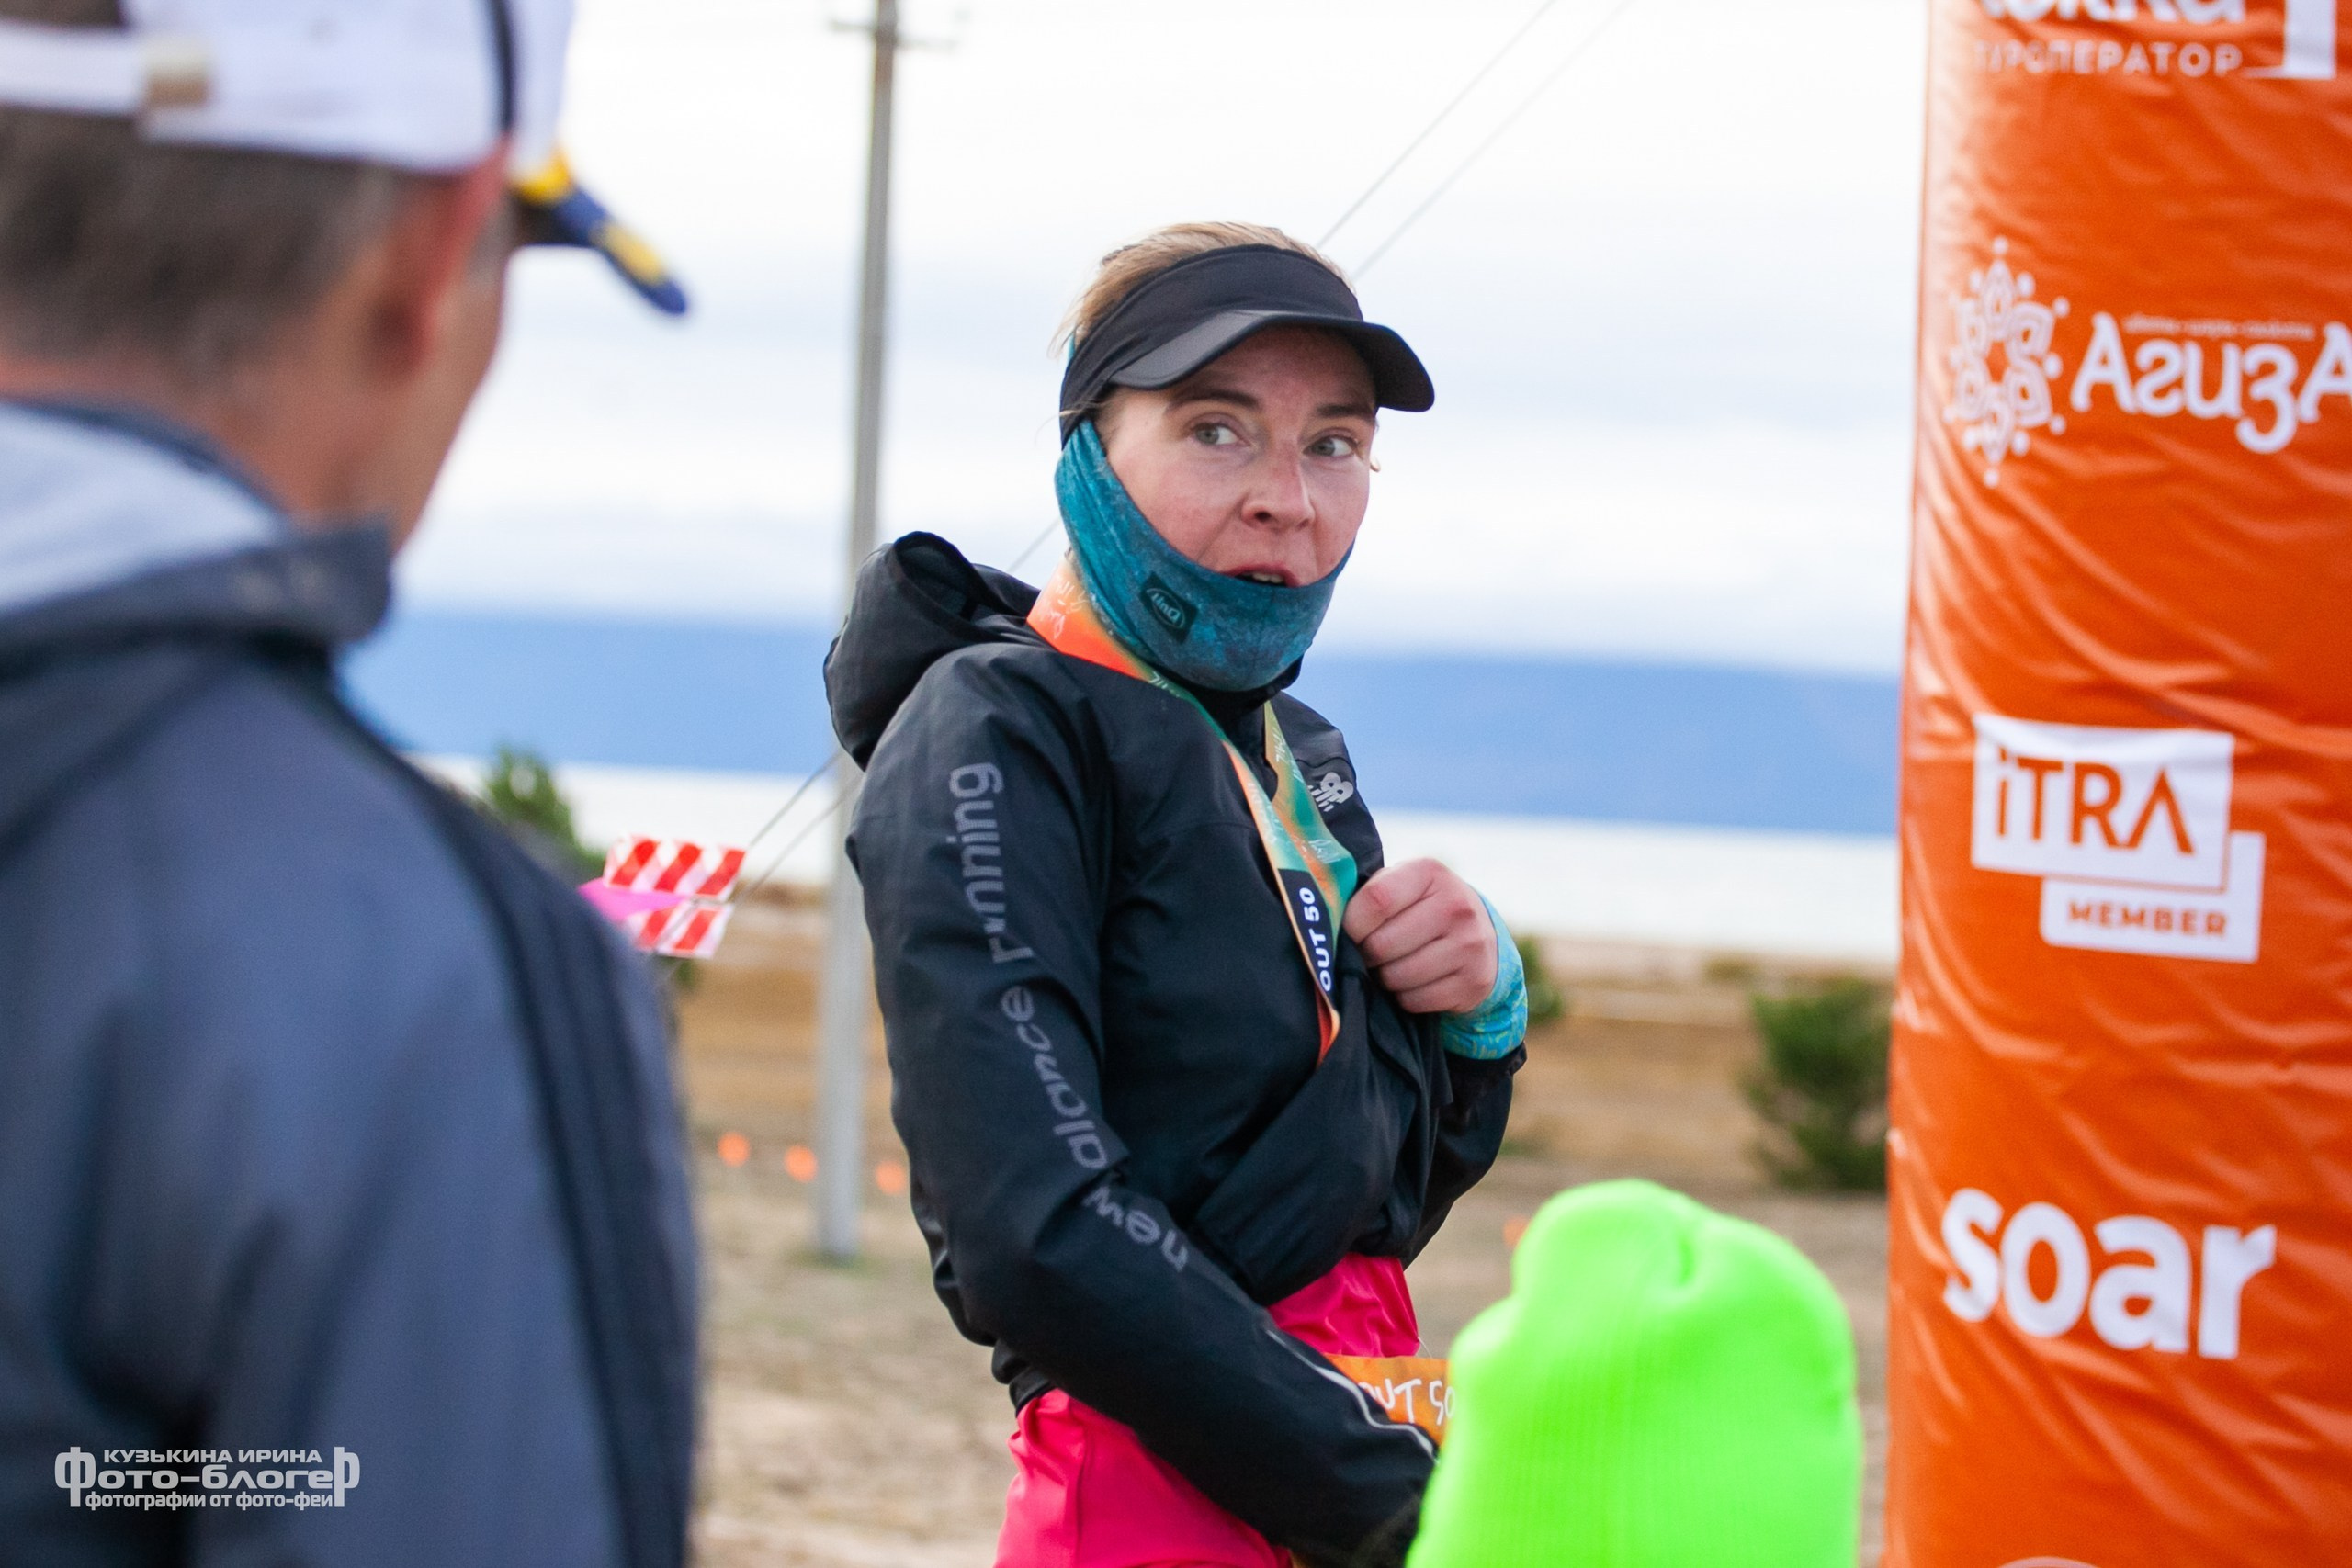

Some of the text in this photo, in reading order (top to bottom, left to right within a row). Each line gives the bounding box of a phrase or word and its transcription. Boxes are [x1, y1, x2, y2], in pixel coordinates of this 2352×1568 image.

[1299, 887, 1333, 992] OUT 50
[2066, 900, 2230, 939] MEMBER
[1001, 985, 1108, 1170] alance
[1082, 1186, 1189, 1273] new
[1940, 1187, 2278, 1361] soar
